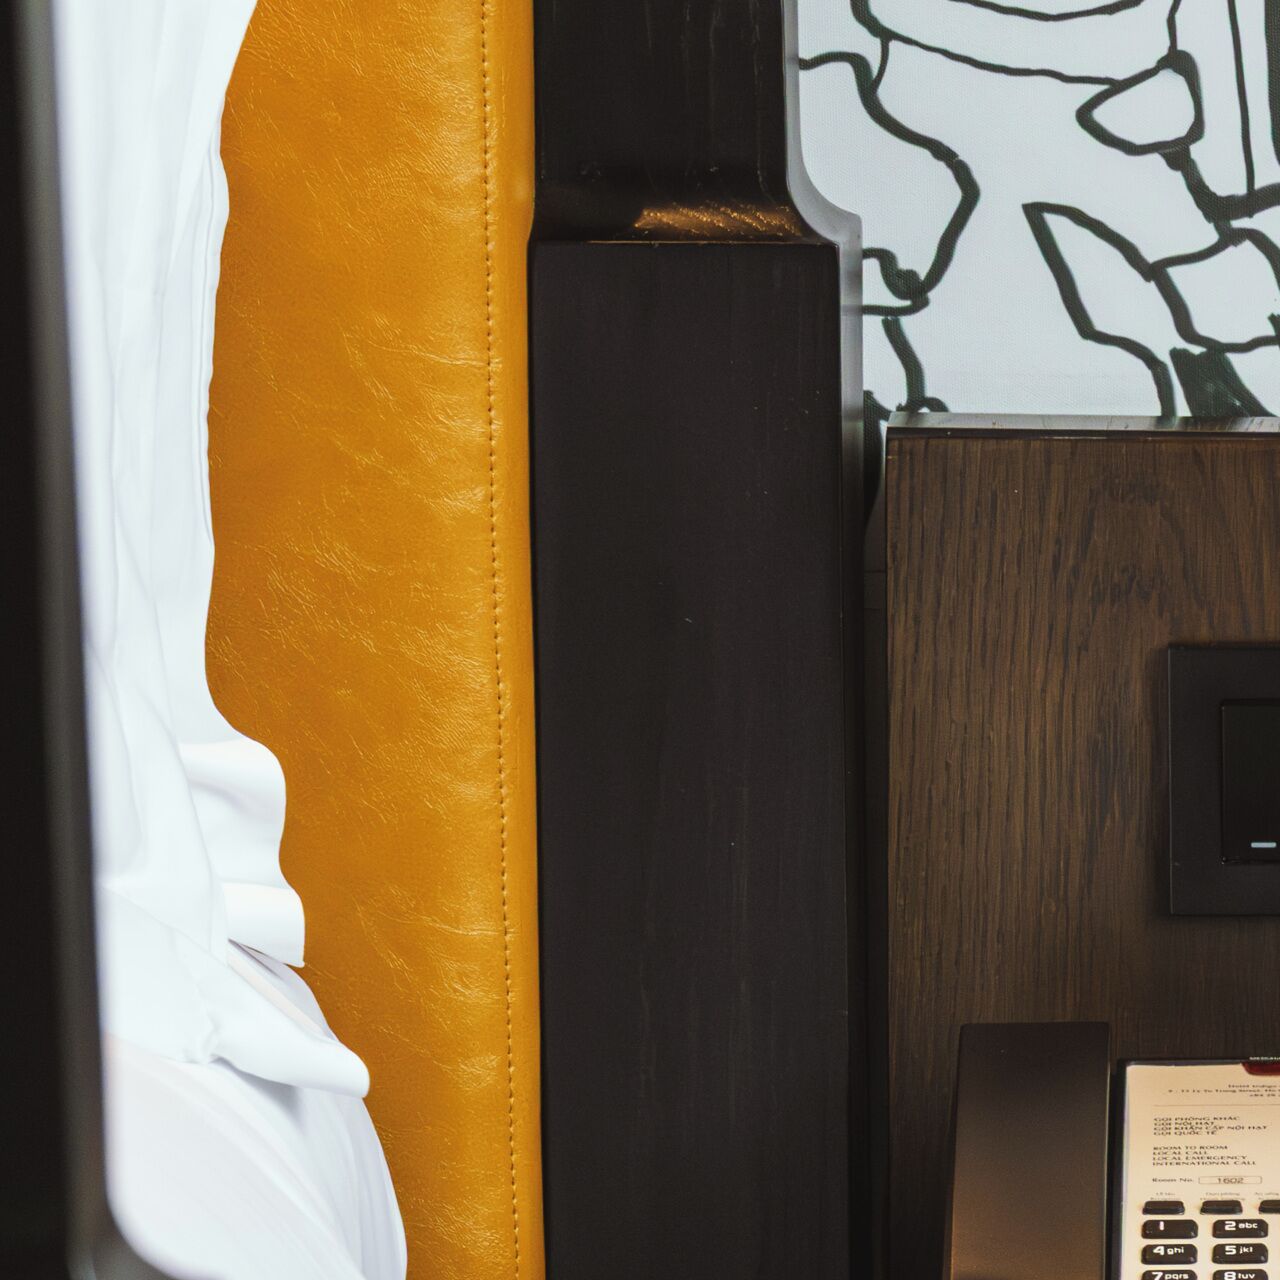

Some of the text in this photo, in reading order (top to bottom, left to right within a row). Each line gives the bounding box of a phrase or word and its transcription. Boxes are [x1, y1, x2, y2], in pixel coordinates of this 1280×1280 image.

[1159, 1221, 1165, 1230] 1
[1225, 1221, 1236, 1230] 2
[1153, 1245, 1184, 1255] 4 ghi
[1225, 1245, 1253, 1255] 5 jkl
[1164, 1272, 1189, 1280] pqrs
[1224, 1271, 1236, 1280] 8
